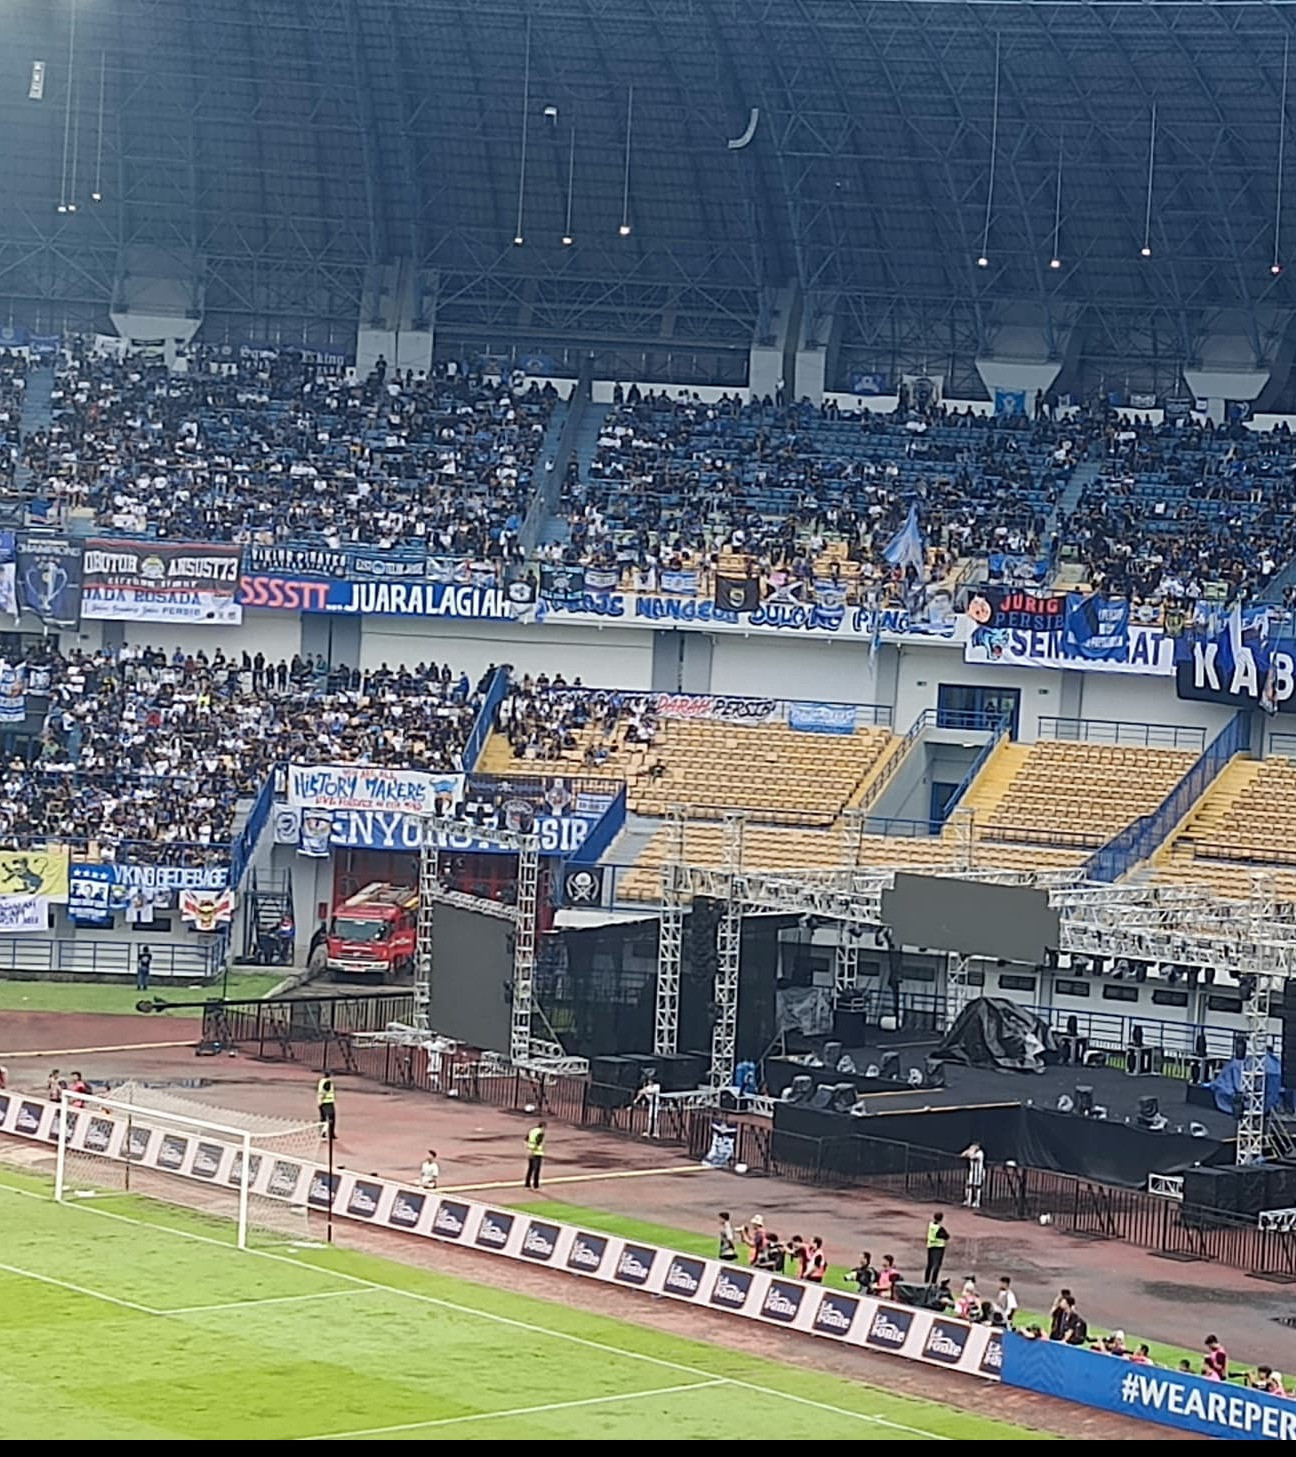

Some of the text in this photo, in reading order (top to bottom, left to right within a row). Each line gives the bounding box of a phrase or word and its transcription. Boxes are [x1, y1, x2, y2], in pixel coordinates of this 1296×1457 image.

[1000, 593, 1058, 613] JURIG
[994, 612, 1064, 630] PERSIB
[656, 696, 711, 715] DARAH
[365, 777, 425, 801] MAKERS
[822, 1300, 833, 1312] La
[817, 1311, 850, 1329] Fonte
[875, 1313, 887, 1325] La
[871, 1324, 906, 1343] Fonte
[931, 1326, 943, 1338] La
[926, 1338, 962, 1356] Fonte
